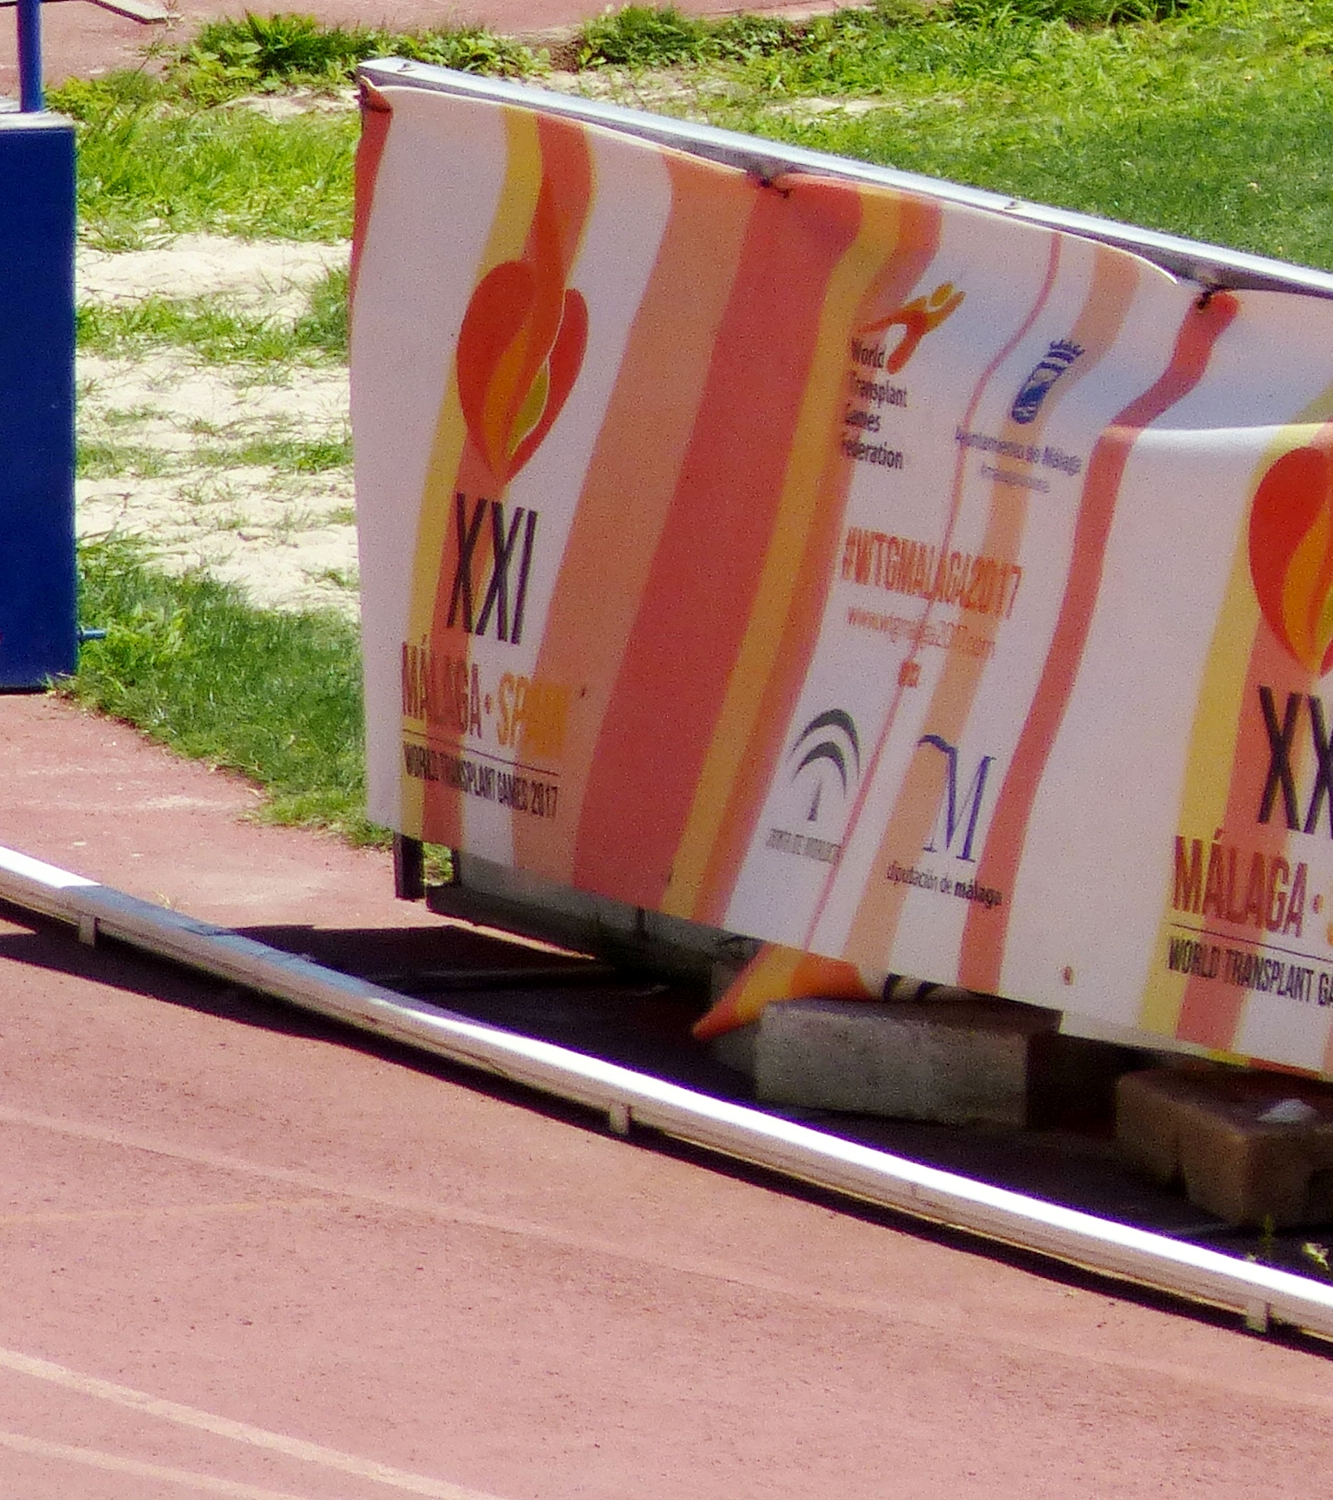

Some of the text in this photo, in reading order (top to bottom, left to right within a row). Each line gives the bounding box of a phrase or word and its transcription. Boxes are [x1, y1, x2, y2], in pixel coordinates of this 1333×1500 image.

[851, 338, 886, 368] World
[446, 492, 538, 645] XXI
[401, 633, 482, 739] MÁLAGA
[1172, 828, 1308, 938] MÁLAGA
[1167, 936, 1222, 979] WORLD
[1222, 948, 1315, 1003] TRANSPLANT
